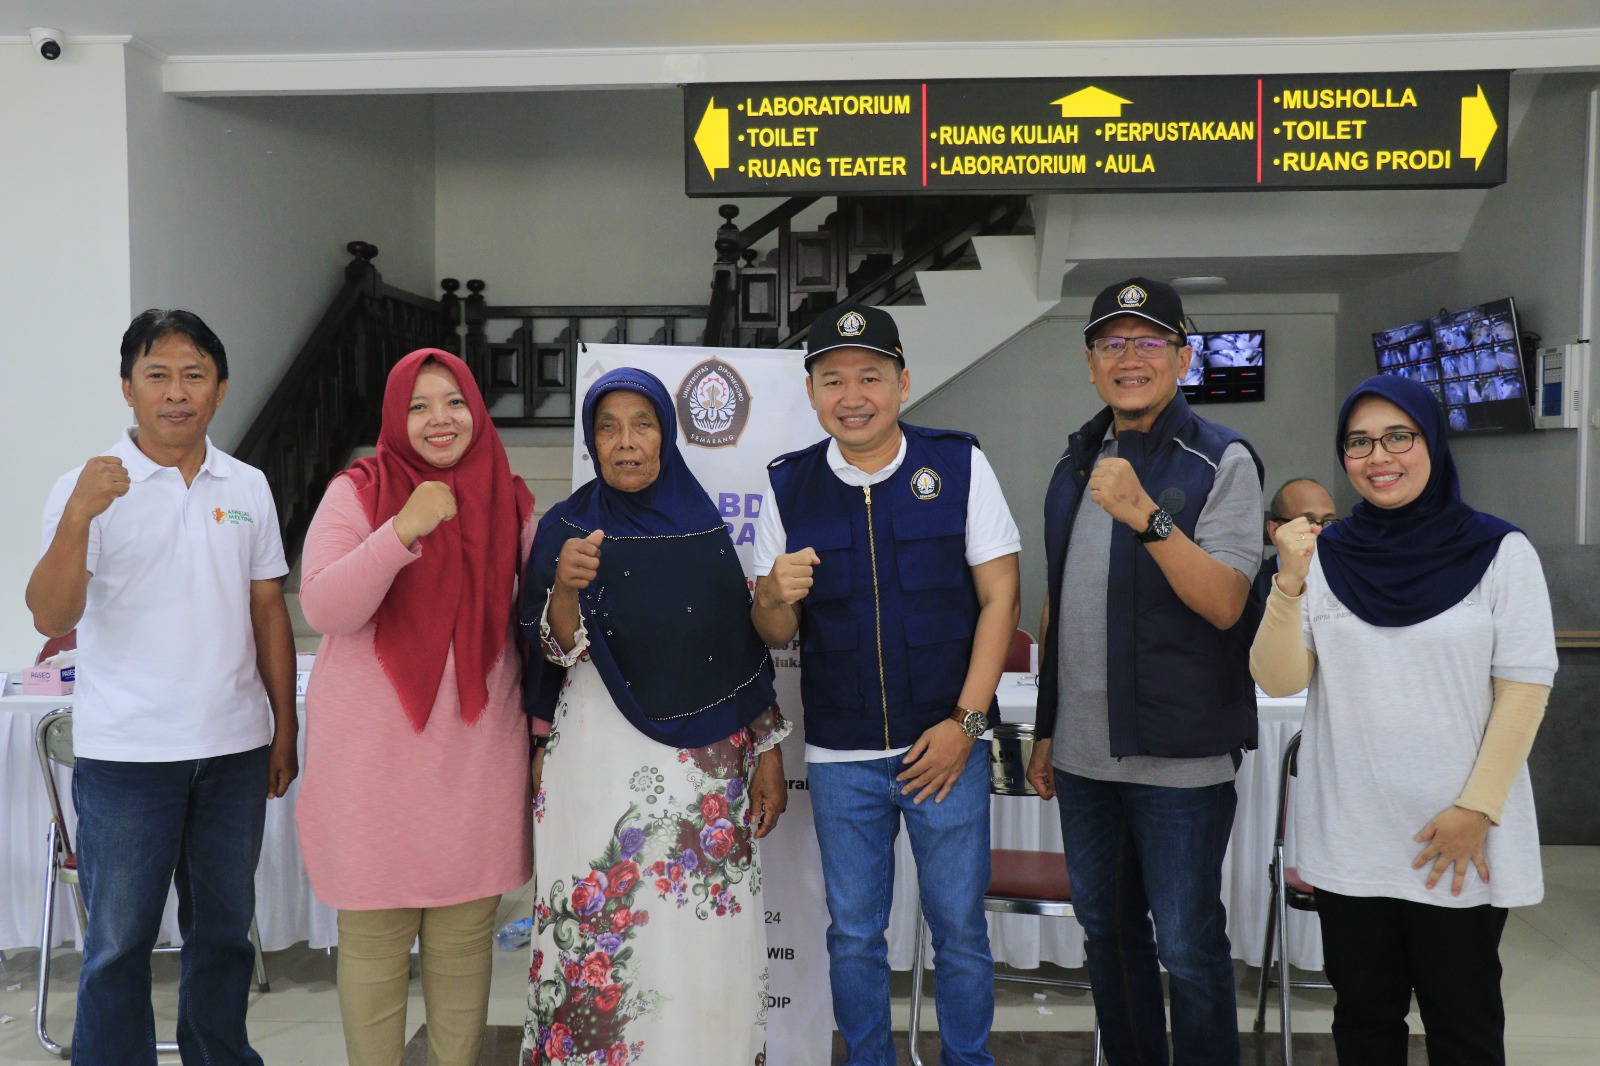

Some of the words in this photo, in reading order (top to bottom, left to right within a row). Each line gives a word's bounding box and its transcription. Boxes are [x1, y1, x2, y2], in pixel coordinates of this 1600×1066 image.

[747, 94, 911, 116] LABORATORIUM
[1283, 88, 1418, 109] MUSHOLLA
[747, 127, 819, 147] TOILET
[940, 125, 1006, 145] RUANG
[1011, 125, 1079, 144] KULIAH
[1104, 122, 1254, 142] PERPUSTAKAAN
[1282, 120, 1367, 140] TOILET
[748, 158, 821, 178] RUANG
[827, 157, 907, 177] TEATER
[940, 155, 1086, 175] LABORATORIUM
[1104, 154, 1156, 173] AULA
[1283, 151, 1369, 171] RUANG
[1376, 150, 1451, 170] PRODI
[682, 365, 709, 399] UNIVERSITAS
[717, 365, 744, 402] DIPONEGORO
[690, 433, 734, 444] SEMARANG
[767, 947, 795, 960] WIB
